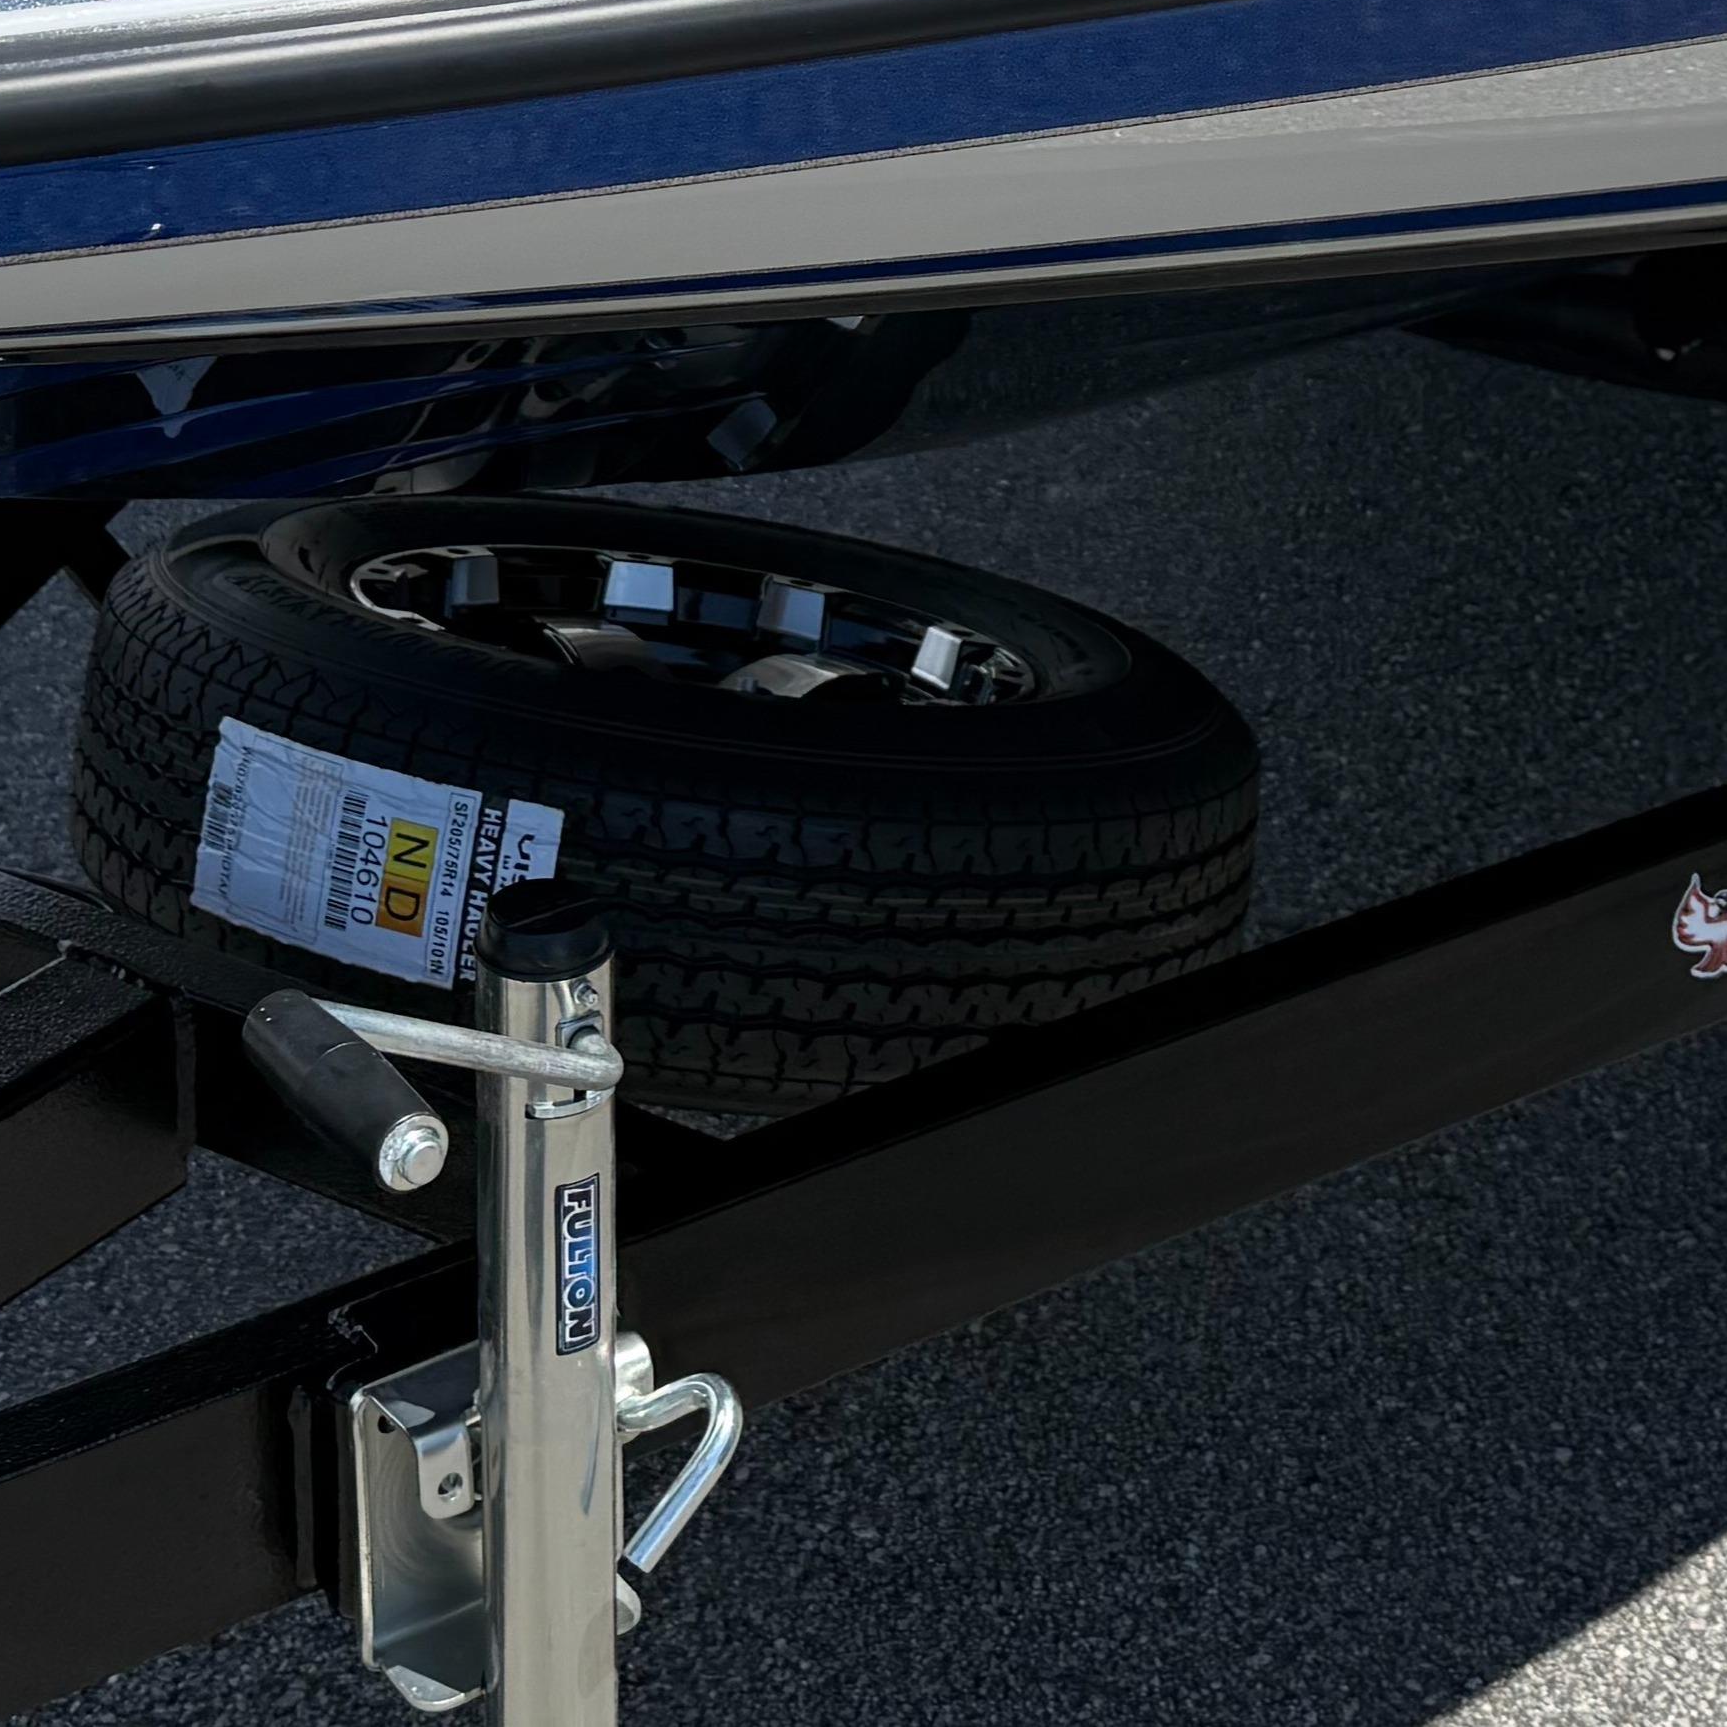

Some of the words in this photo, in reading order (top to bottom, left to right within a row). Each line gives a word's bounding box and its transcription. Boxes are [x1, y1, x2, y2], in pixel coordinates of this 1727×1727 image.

[350, 814, 389, 926] 104610
[393, 831, 431, 869] N
[441, 801, 469, 897] ST205/75R14
[474, 807, 503, 890] HEAVY
[384, 885, 421, 922] D
[460, 889, 489, 982] HAULER
[562, 1184, 596, 1343] FULTON
